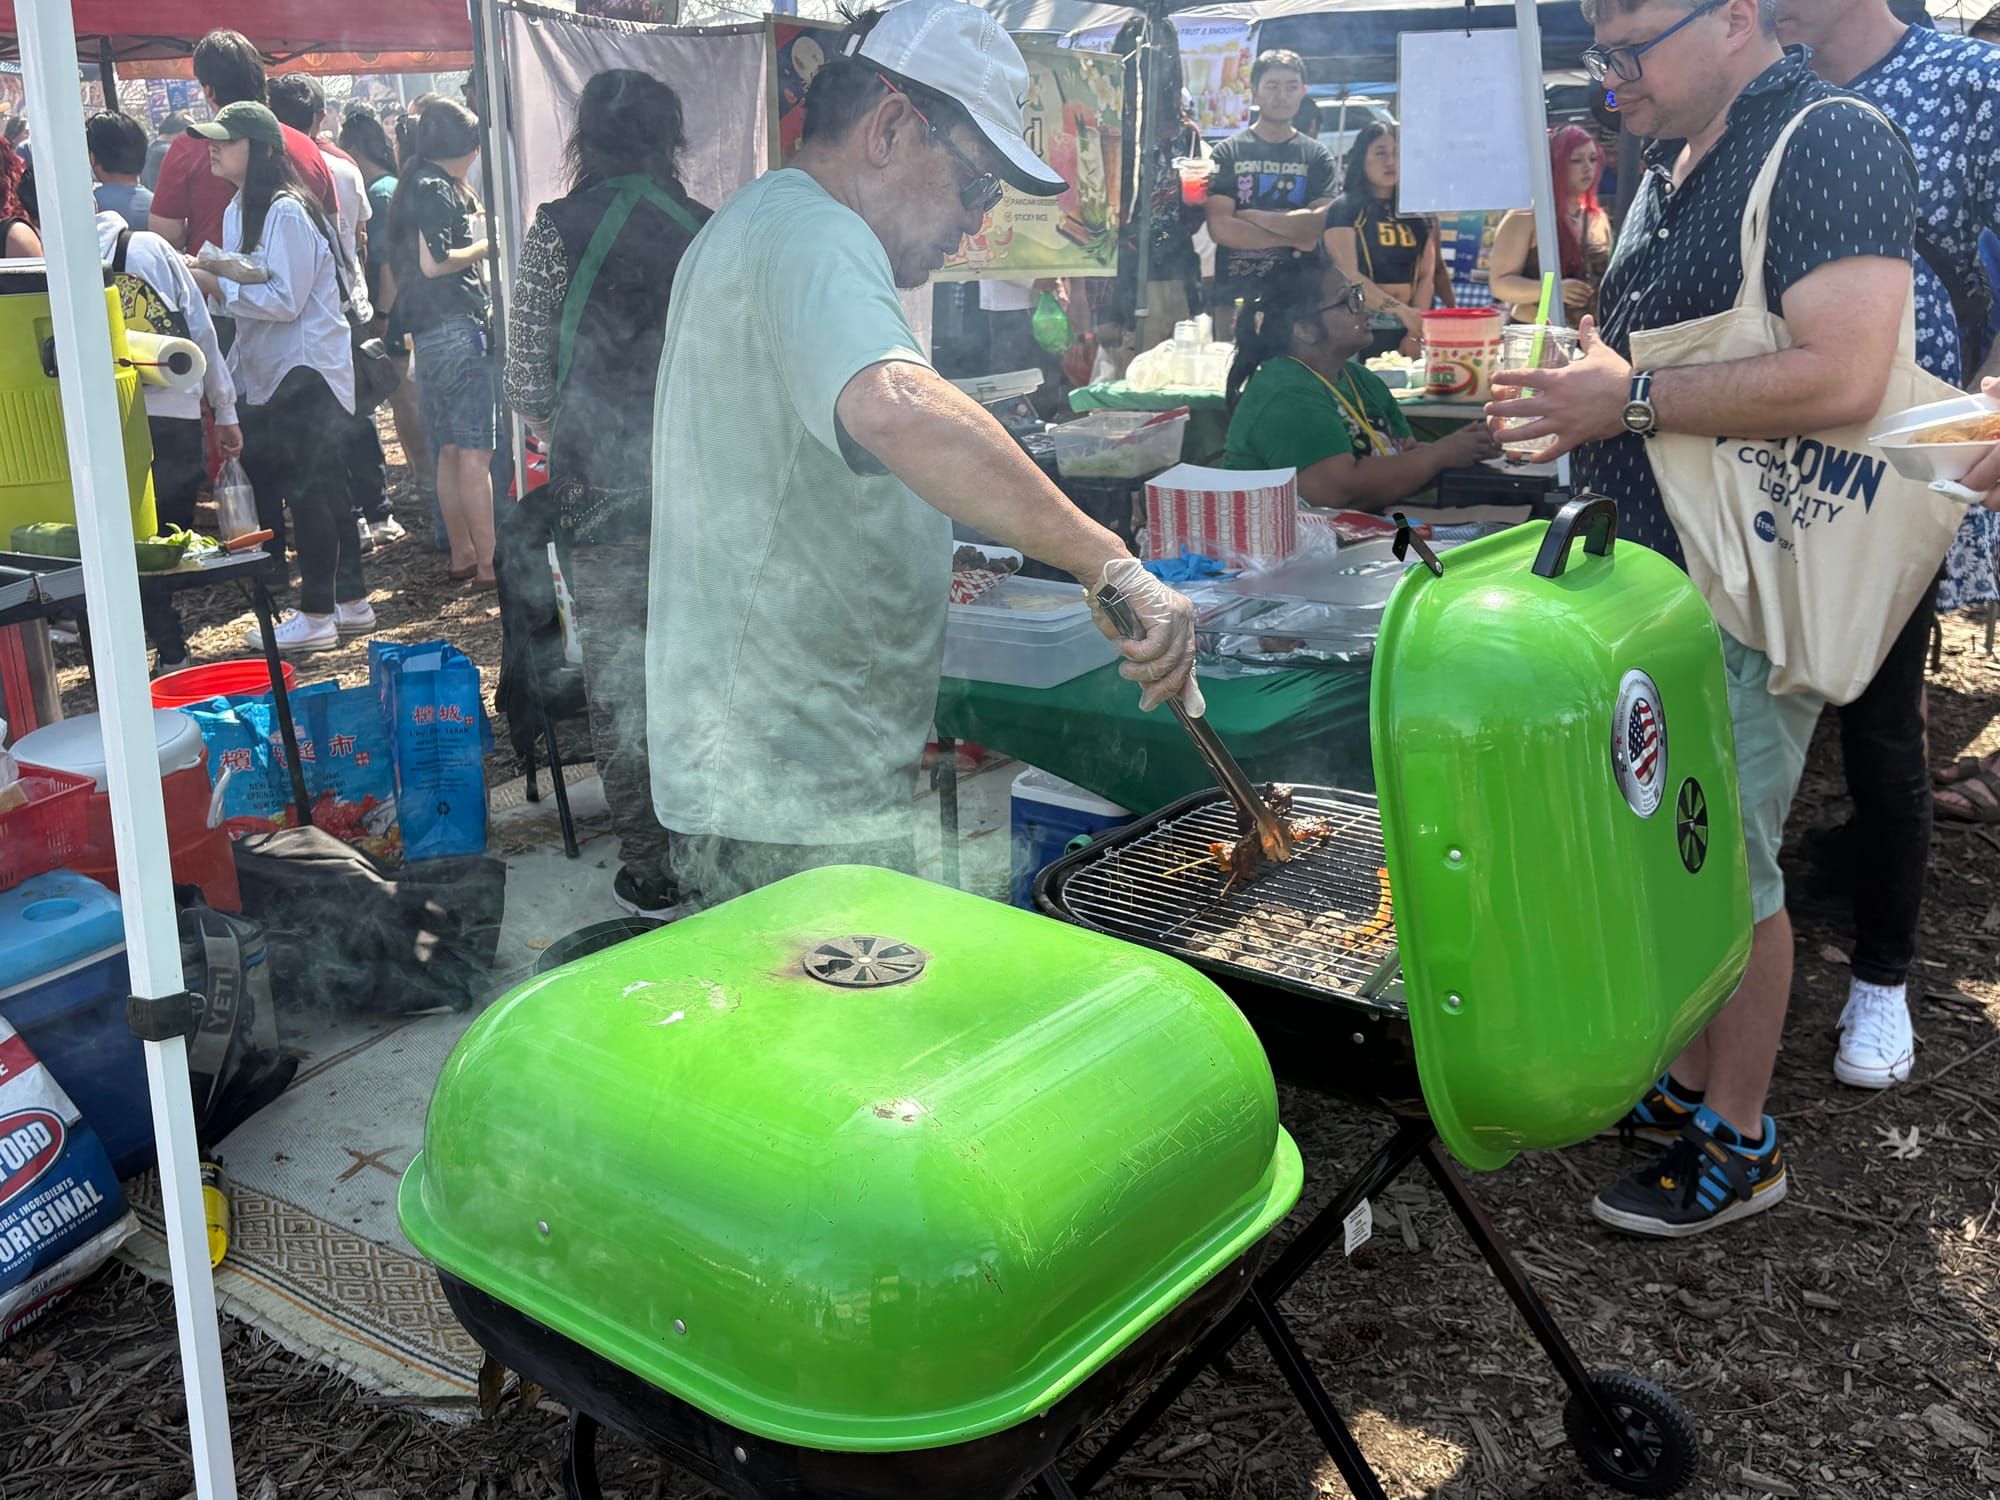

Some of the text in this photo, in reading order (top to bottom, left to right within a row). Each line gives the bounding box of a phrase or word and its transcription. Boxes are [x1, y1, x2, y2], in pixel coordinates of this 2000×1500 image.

[1014, 213, 1049, 222] STICKY RICE
[1756, 516, 1776, 535] free
[208, 973, 232, 1028] YETI
[18, 1177, 75, 1217] INGREDIENTS
[0, 1180, 104, 1263] ORIGINAL
[37, 1227, 69, 1251] BRIQUETAS
[69, 1222, 77, 1231] DE
